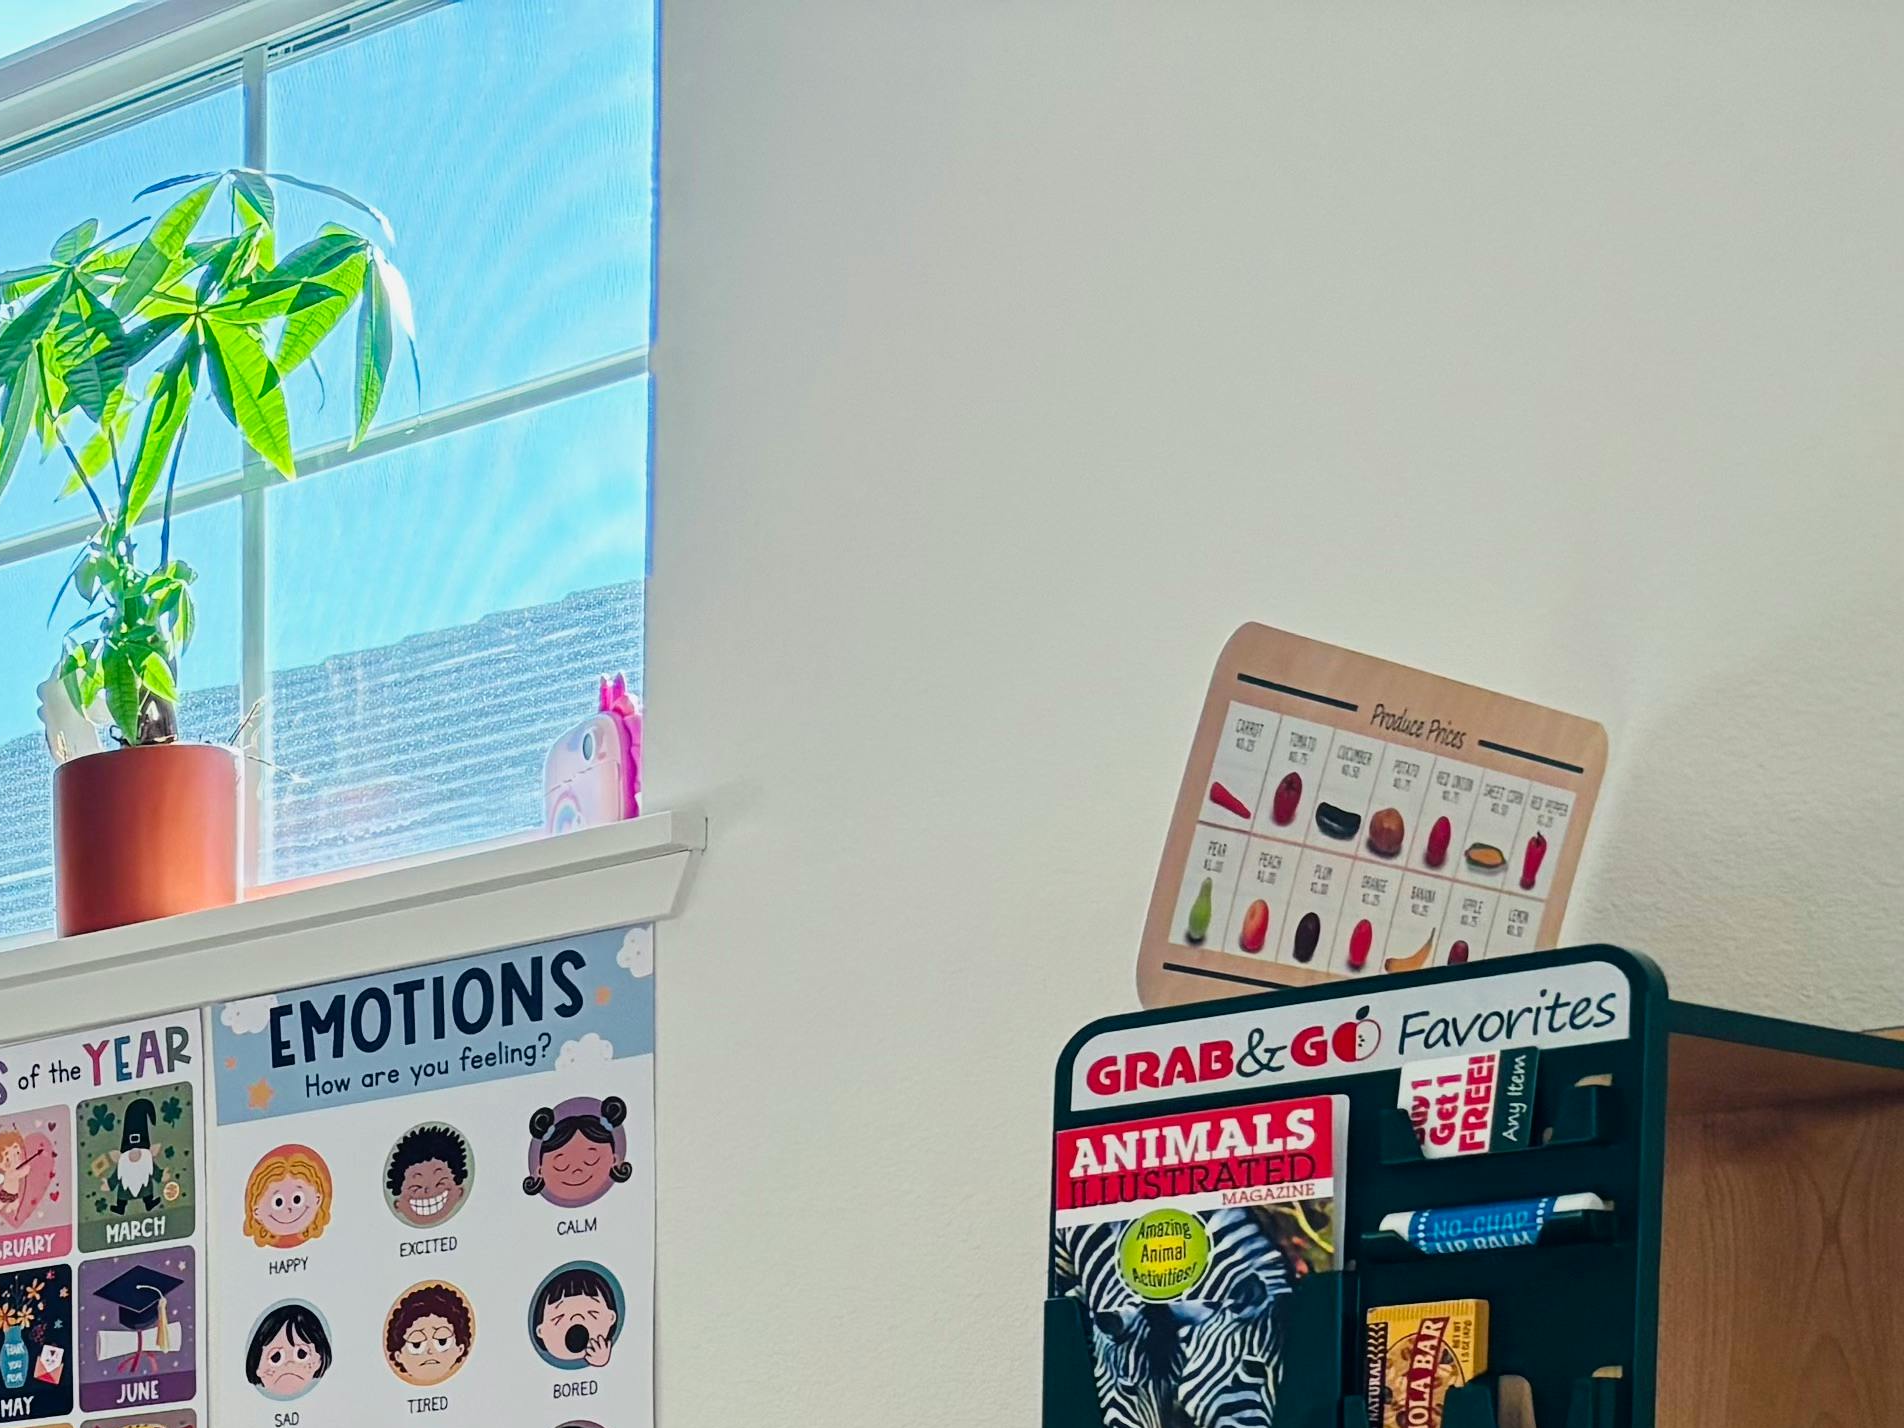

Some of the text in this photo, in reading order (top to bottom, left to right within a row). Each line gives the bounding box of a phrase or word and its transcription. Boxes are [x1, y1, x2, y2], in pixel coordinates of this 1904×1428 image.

[1370, 704, 1468, 750] Produce Prices
[268, 949, 587, 1070] EMOTIONS
[1398, 989, 1616, 1055] Favorites
[18, 1063, 40, 1091] of
[48, 1059, 81, 1084] the
[82, 1025, 192, 1087] YEAR
[305, 1032, 553, 1099] How are you feeling?
[1458, 1054, 1496, 1153] FREE!
[1502, 1054, 1528, 1142] Any Item
[1429, 1092, 1460, 1146] Get
[1069, 1107, 1315, 1178] ANIMALS
[1071, 1152, 1317, 1209] ILLUSTRATED
[1221, 1183, 1315, 1206] MAGAZINE
[105, 1216, 166, 1244] MARCH
[556, 1217, 598, 1237] CALM
[1136, 1219, 1192, 1241] Amazing
[399, 1237, 458, 1258] EXCITED
[1140, 1240, 1186, 1264] Animal
[268, 1256, 309, 1275] HAPPY
[1131, 1263, 1197, 1288] Activities!
[1414, 1320, 1444, 1371] BAR
[116, 1379, 160, 1404] JUNE
[553, 1380, 599, 1400] BORED
[1368, 1359, 1382, 1422] NATURAL
[0, 1395, 35, 1418] MAY
[274, 1411, 300, 1428] SAD
[407, 1396, 449, 1415] TIRED
